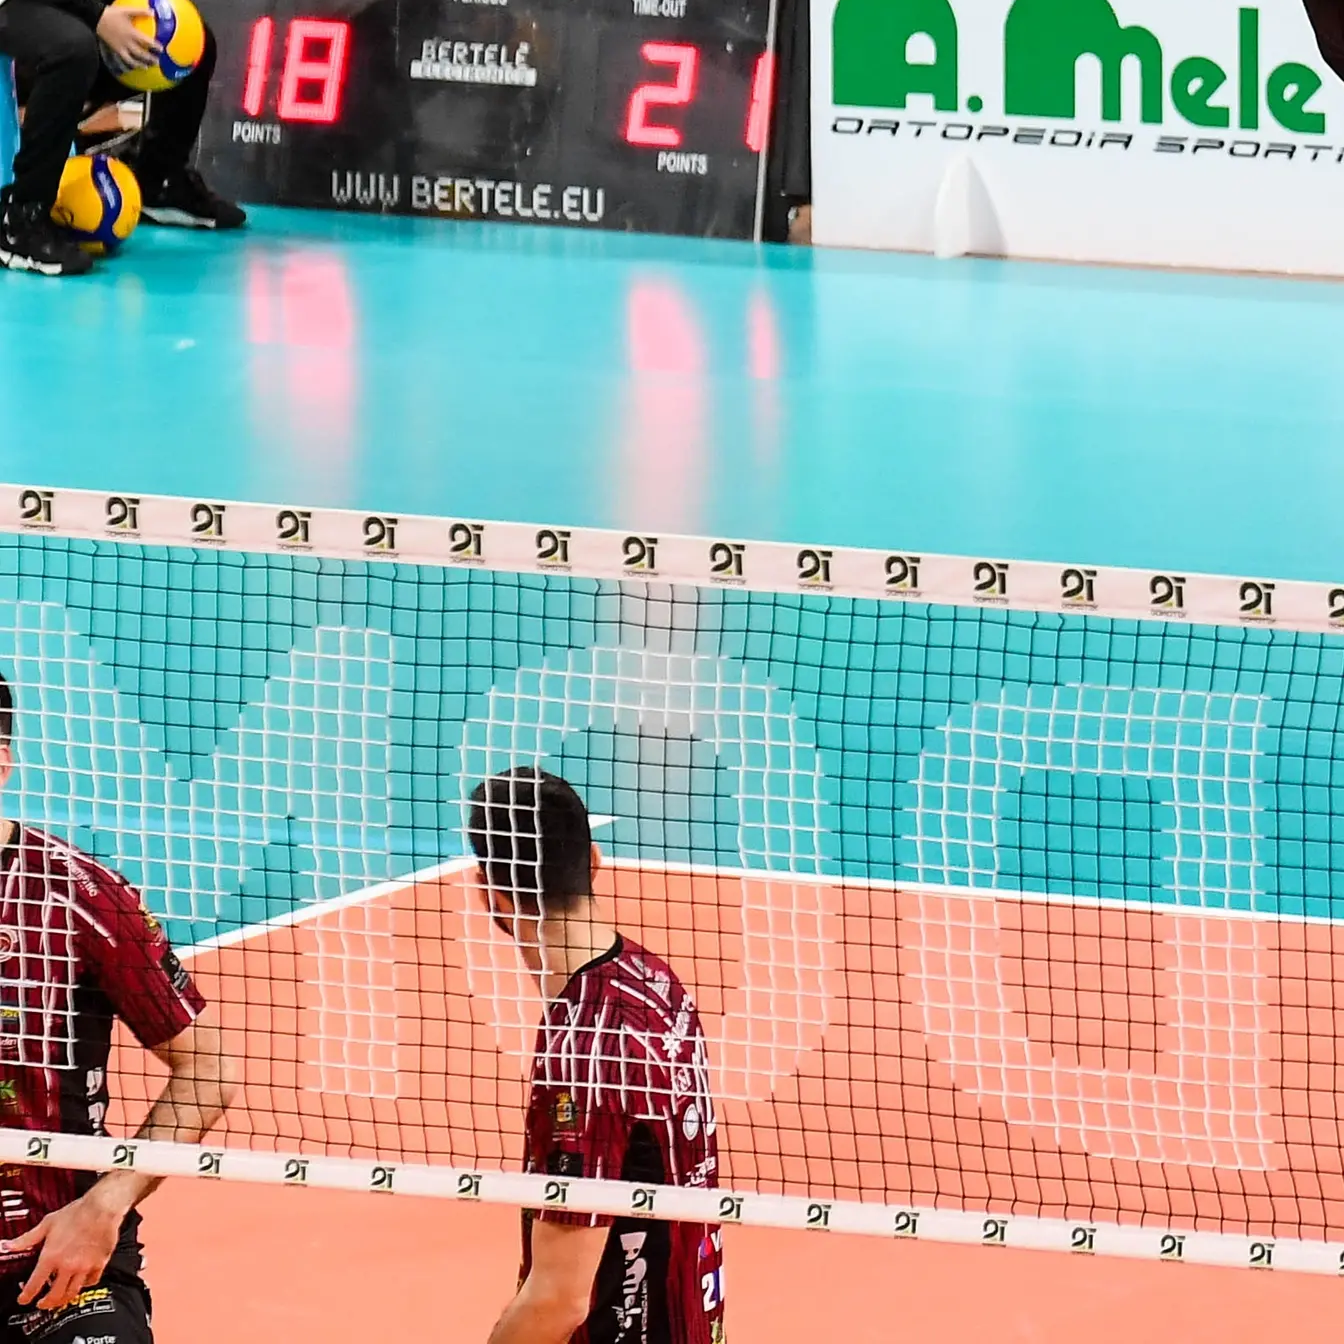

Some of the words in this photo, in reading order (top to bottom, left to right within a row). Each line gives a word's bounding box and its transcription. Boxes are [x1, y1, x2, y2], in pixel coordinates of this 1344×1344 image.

[244, 16, 351, 124] 18
[232, 122, 282, 144] POINTS
[831, 117, 1133, 150] ORTOPEDIA
[657, 153, 708, 175] POINTS
